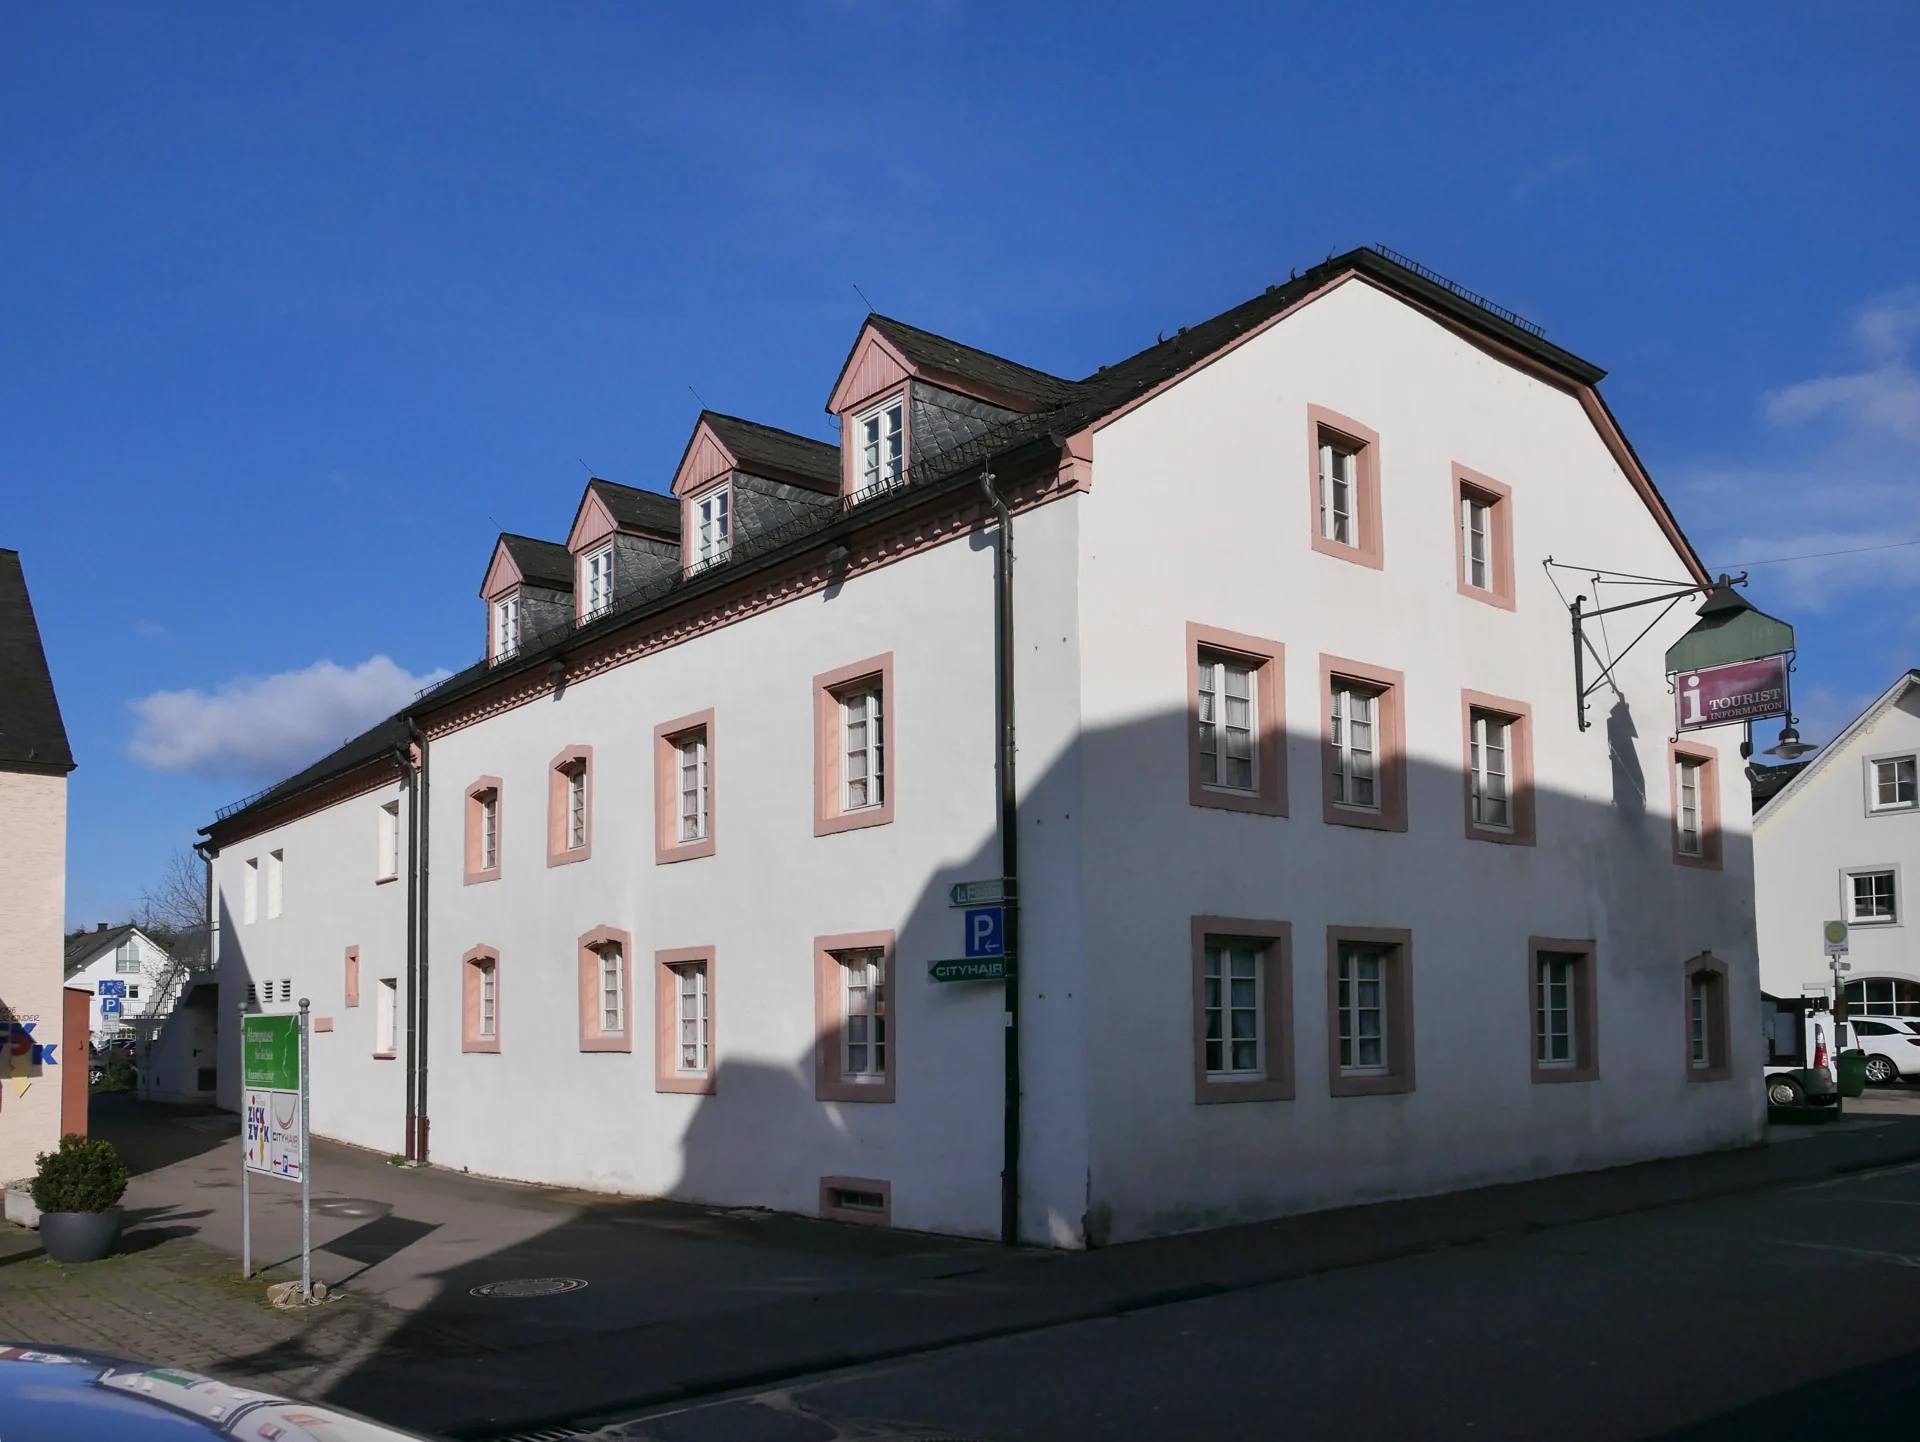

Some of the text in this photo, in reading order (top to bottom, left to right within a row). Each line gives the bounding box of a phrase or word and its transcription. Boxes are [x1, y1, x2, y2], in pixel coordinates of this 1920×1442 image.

[1709, 688, 1781, 710] TOURIST
[1710, 701, 1782, 720] INFORMATION
[973, 914, 994, 951] P
[935, 963, 1003, 977] CITYHAIR
[106, 1000, 116, 1011] P
[11, 1014, 40, 1022] KINDER
[247, 1096, 265, 1123] ZICK
